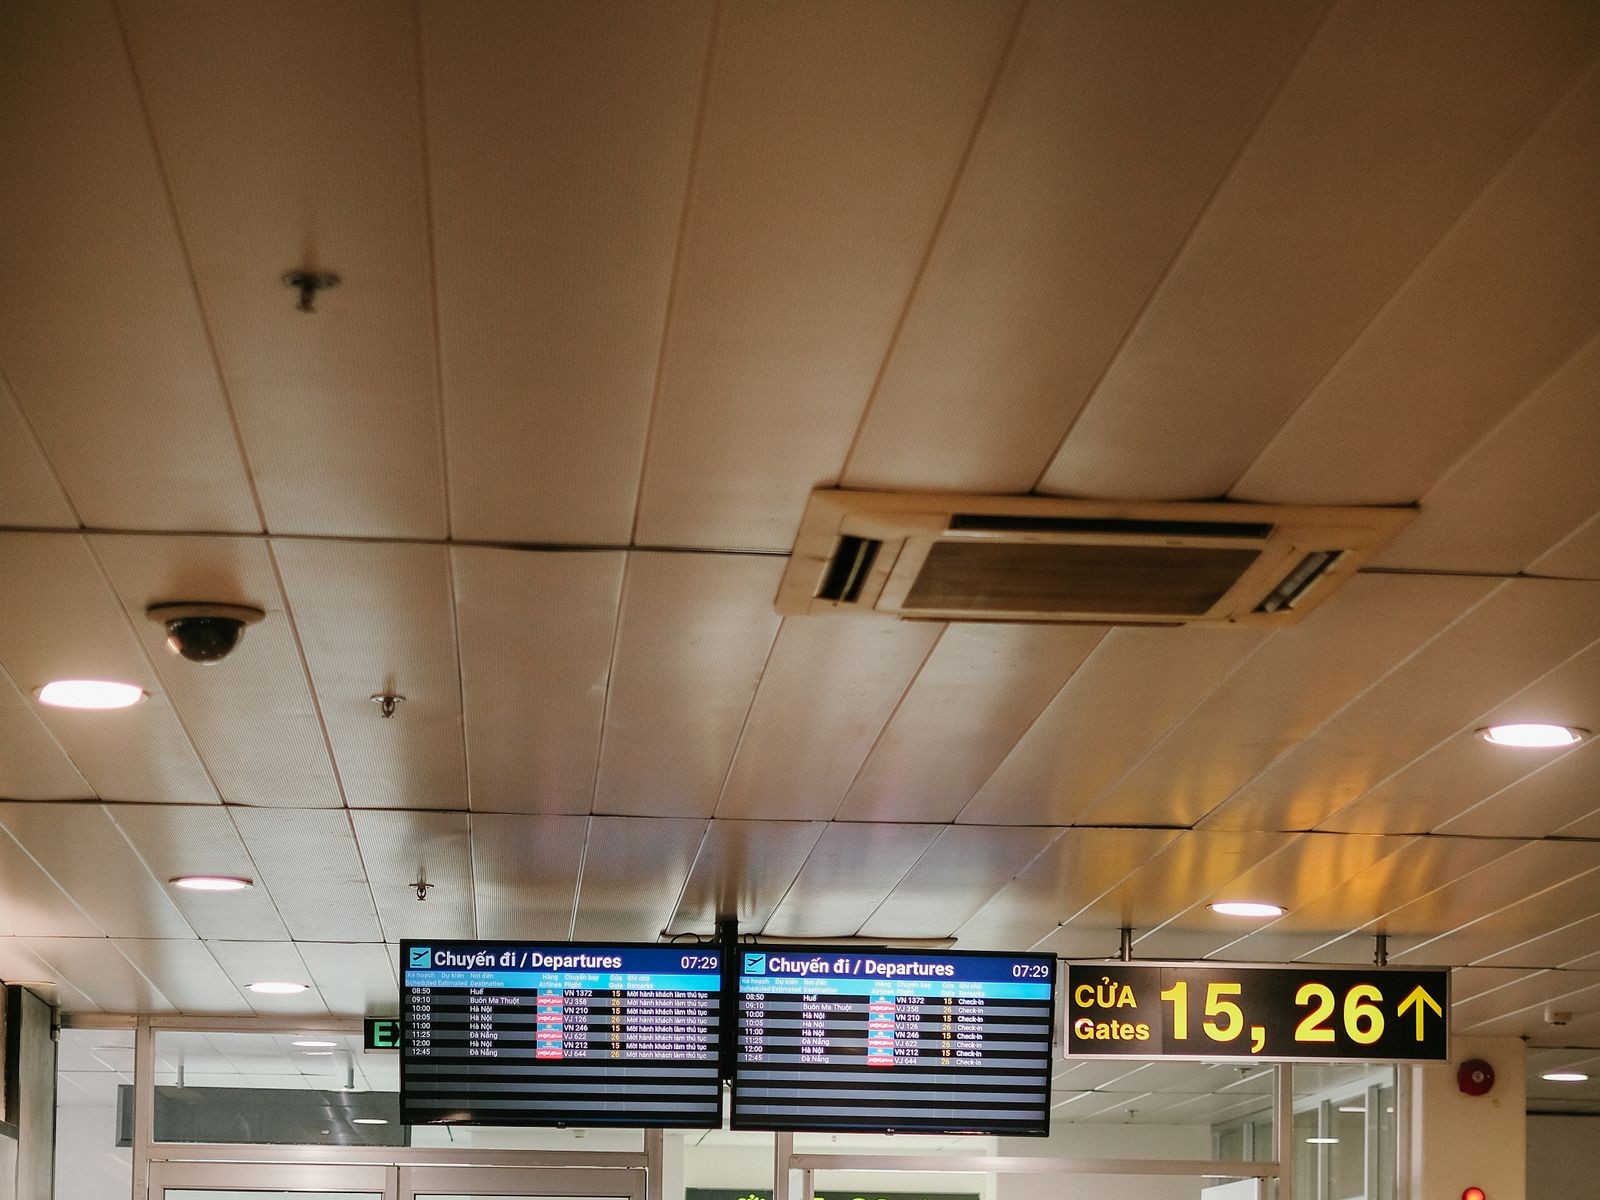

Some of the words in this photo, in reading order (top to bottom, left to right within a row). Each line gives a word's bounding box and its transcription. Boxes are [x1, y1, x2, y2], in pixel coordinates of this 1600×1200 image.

[435, 951, 494, 969] Chuyến
[500, 951, 515, 966] đi
[520, 953, 527, 967] /
[532, 953, 621, 969] Departures
[681, 957, 717, 969] 07:29
[769, 958, 828, 976] Chuyến
[834, 959, 849, 974] đi
[854, 960, 861, 974] /
[865, 960, 954, 977] Departures
[1013, 965, 1048, 977] 07:29
[1075, 977, 1137, 1008] CỬA
[1161, 981, 1266, 1054] 15,
[1294, 983, 1385, 1044] 26
[1075, 1018, 1150, 1041] Gates
